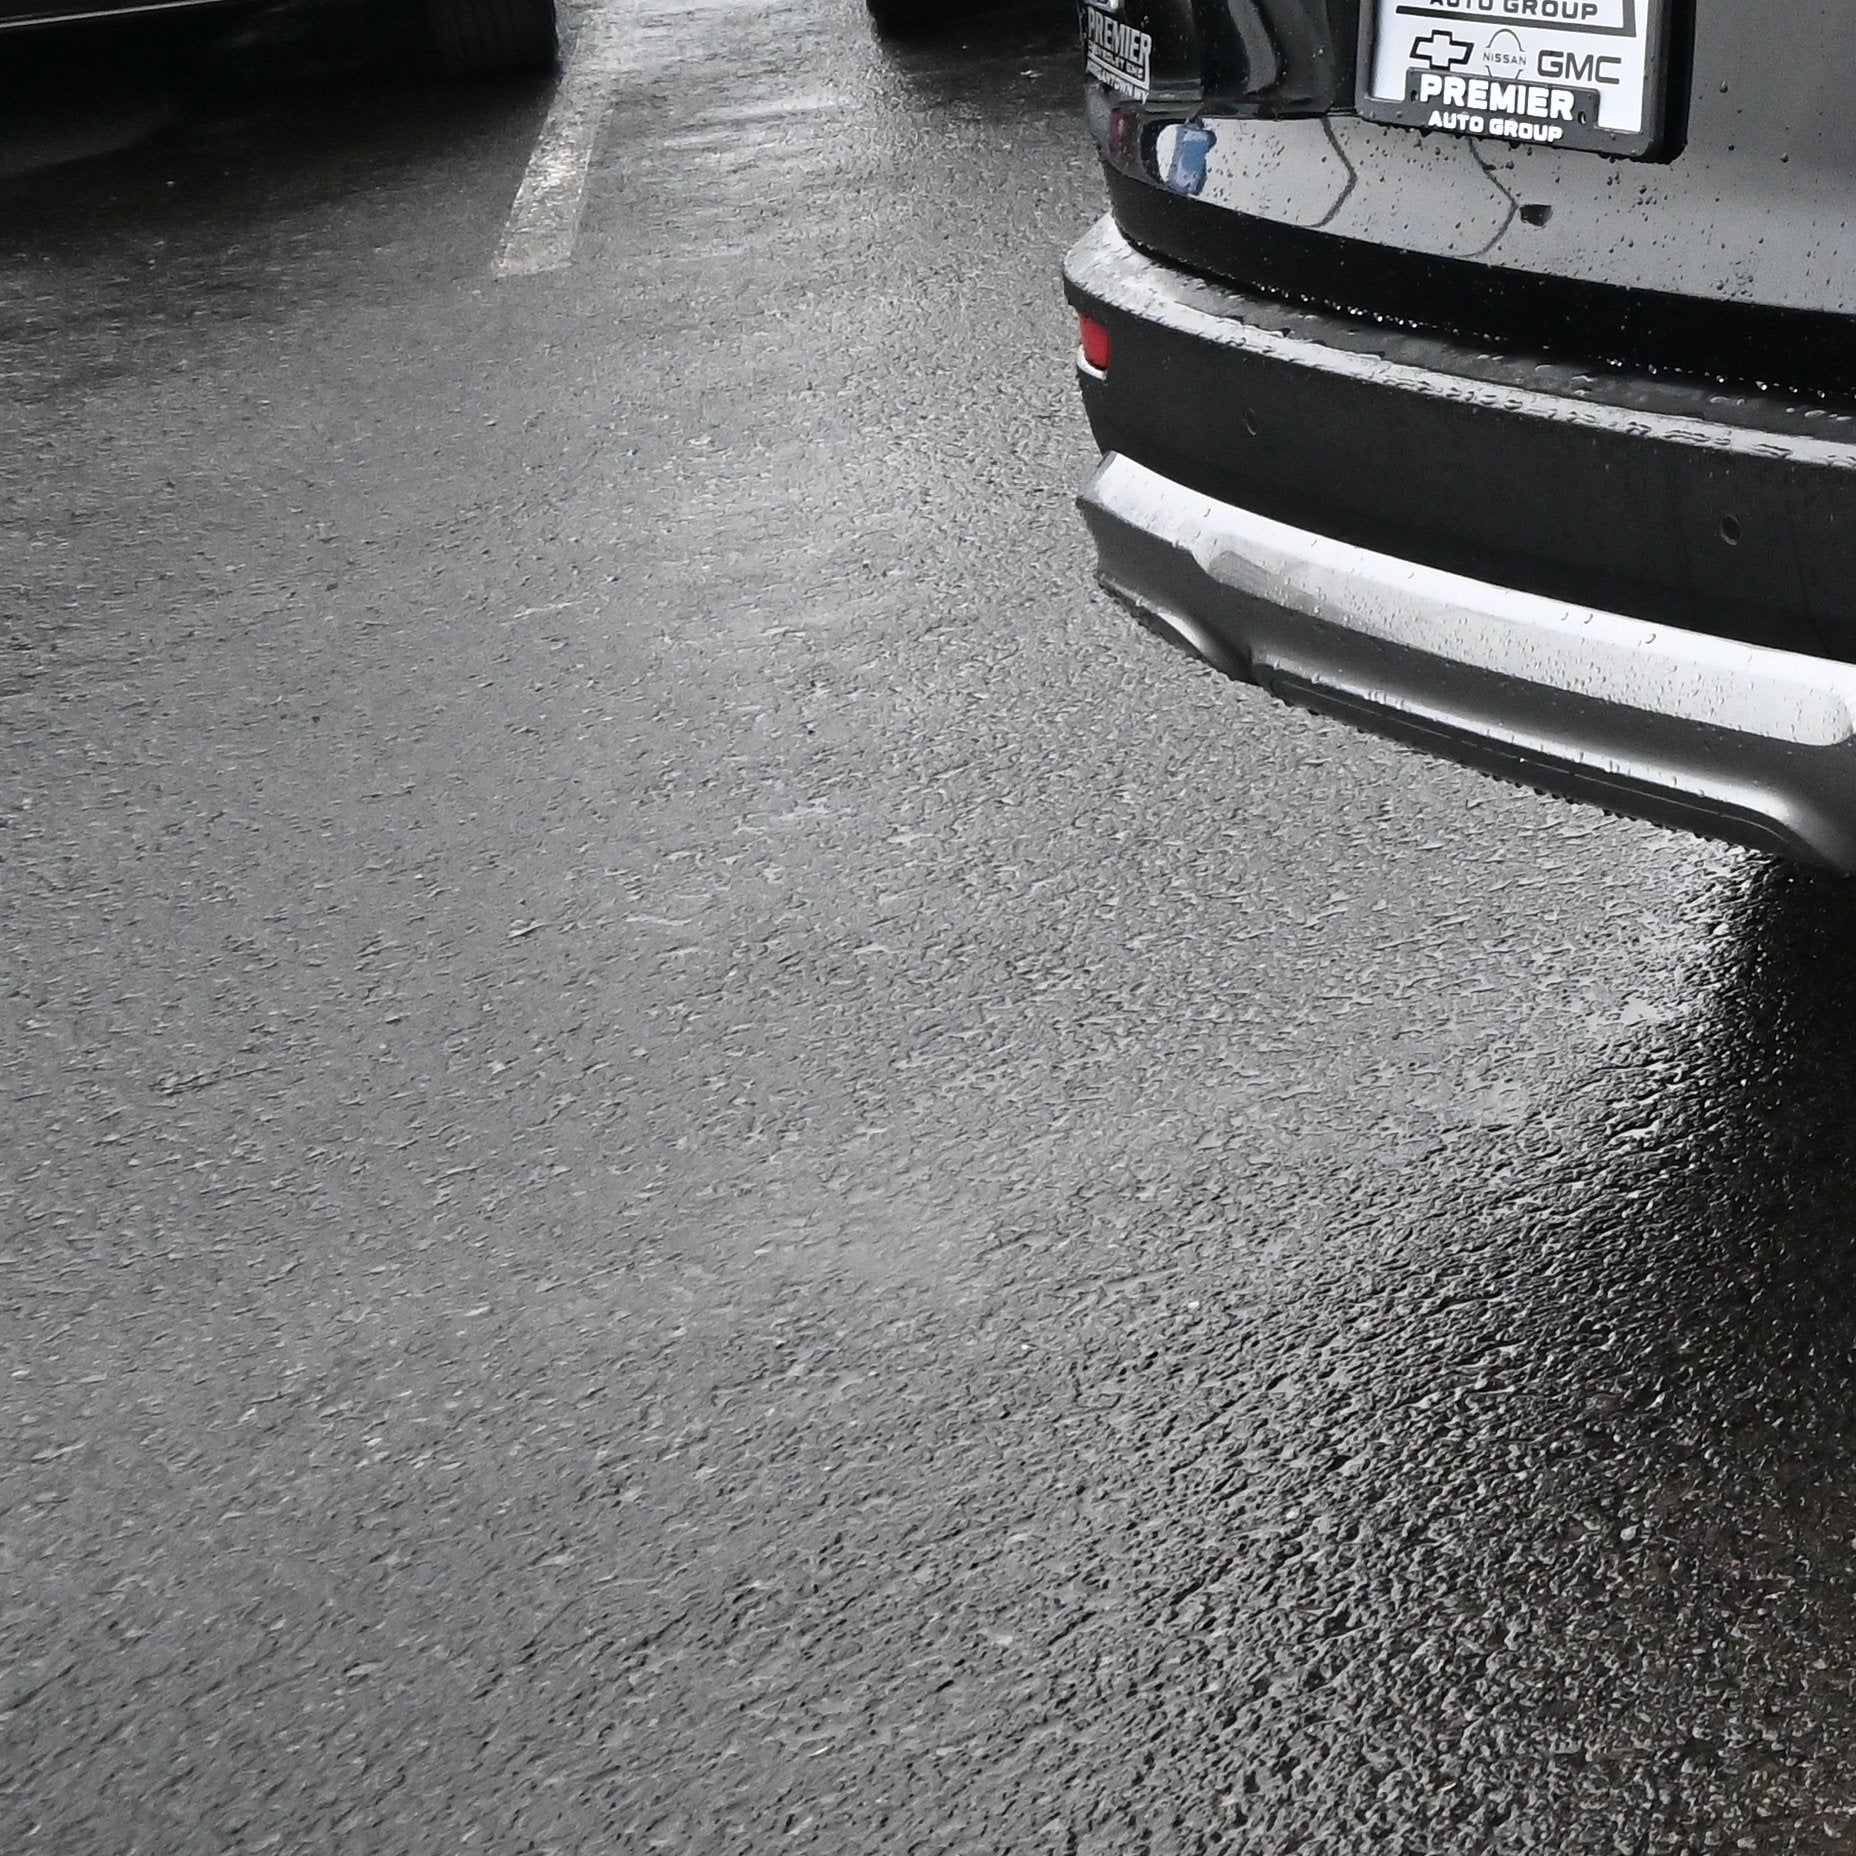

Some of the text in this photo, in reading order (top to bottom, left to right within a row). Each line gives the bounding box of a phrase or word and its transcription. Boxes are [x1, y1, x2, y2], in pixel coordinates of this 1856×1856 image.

[1087, 5, 1152, 67] PREMIER
[1482, 49, 1622, 85] NISSAN GMC
[1419, 74, 1575, 122] PREMIER
[1428, 110, 1564, 143] AUTO GROUP
